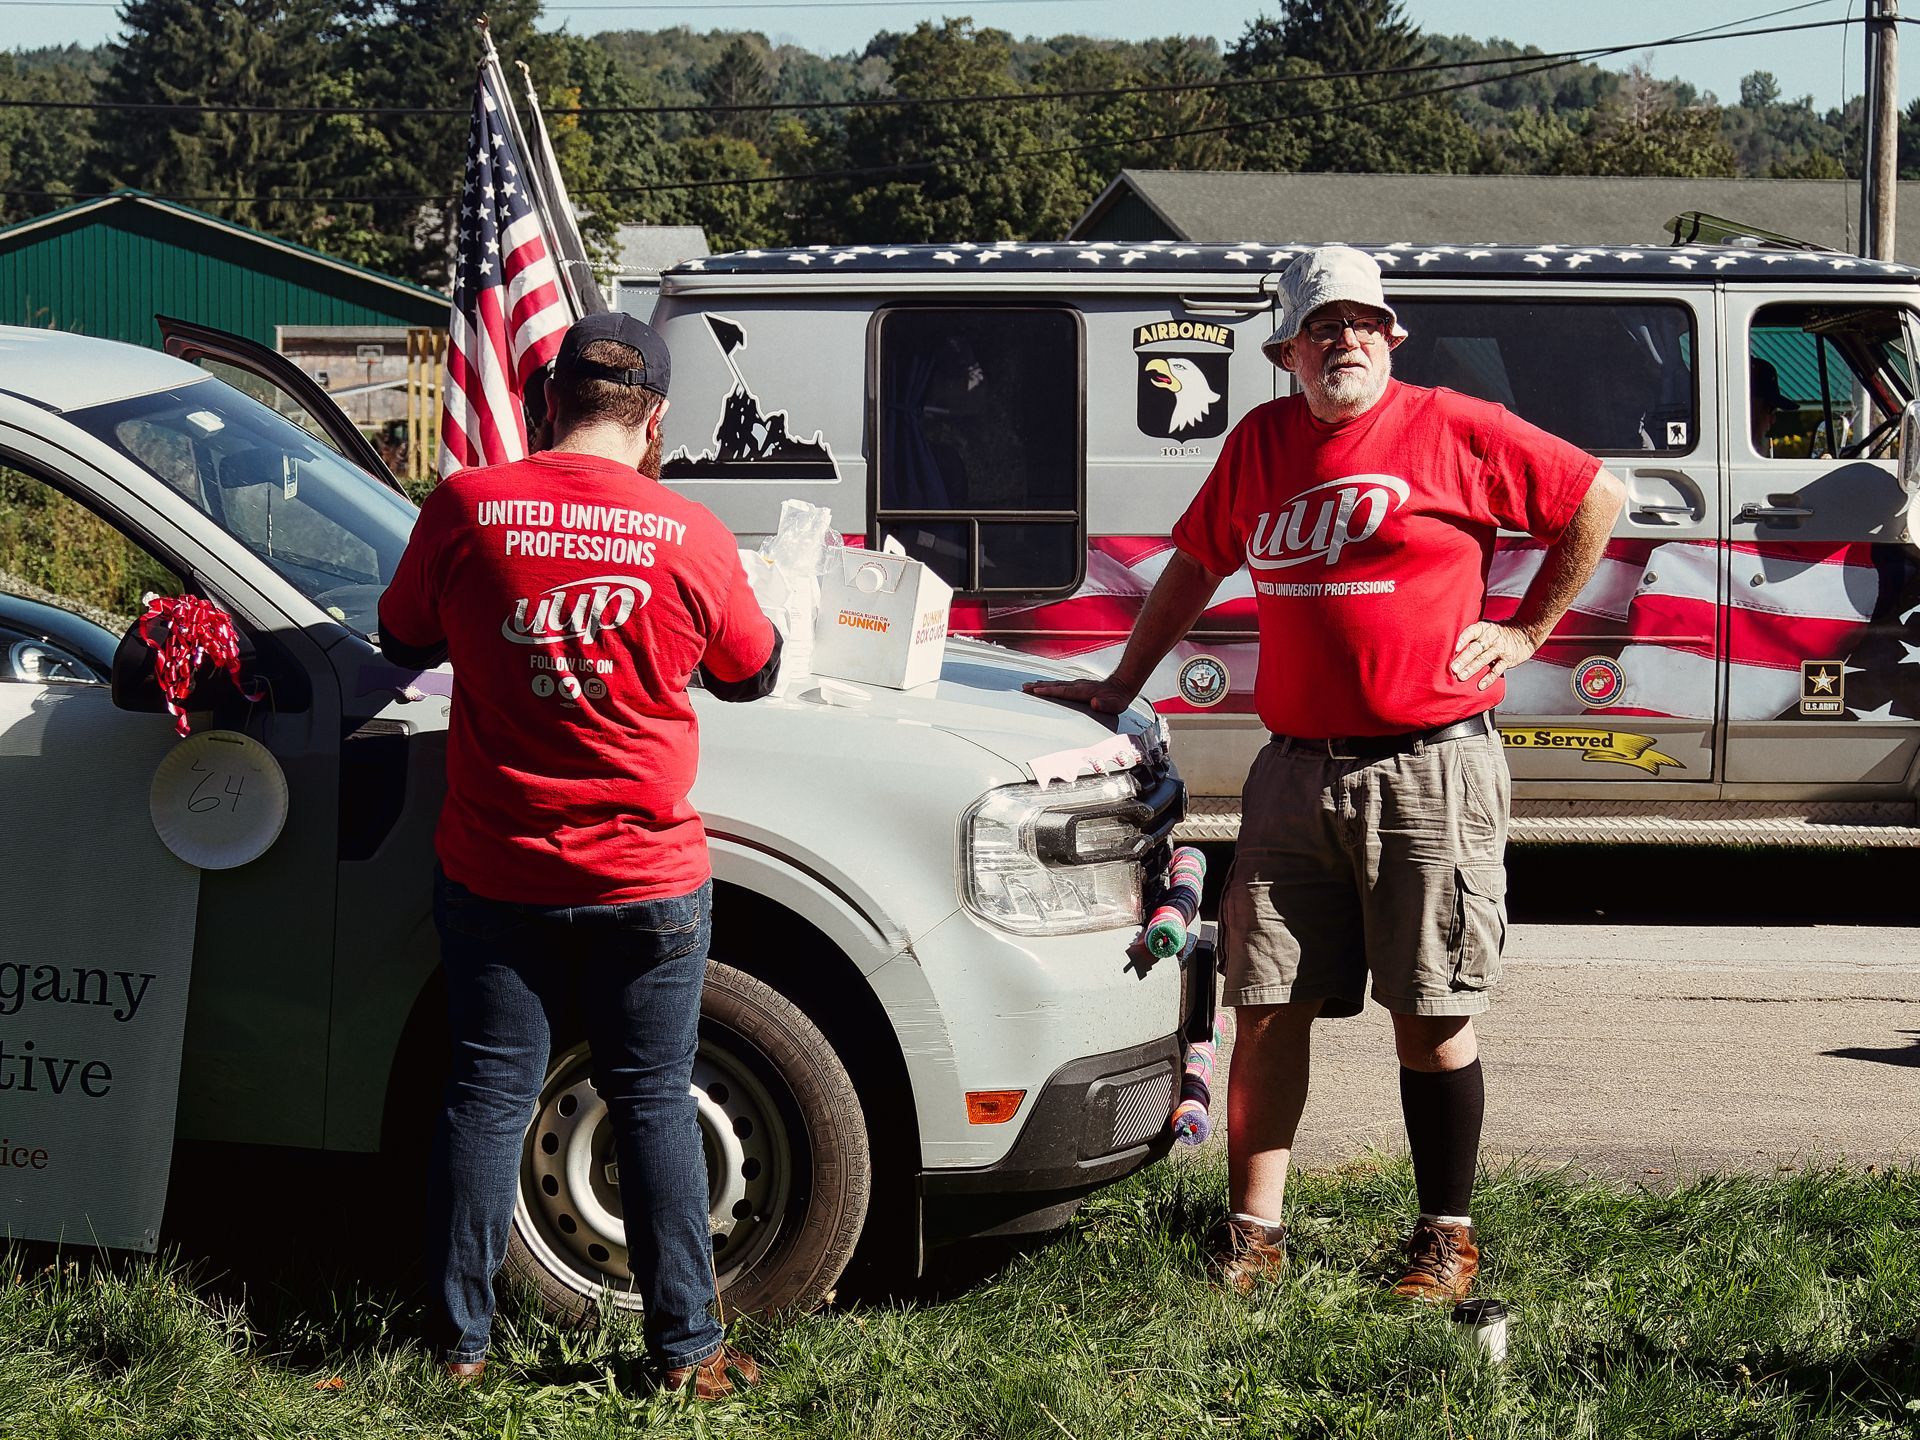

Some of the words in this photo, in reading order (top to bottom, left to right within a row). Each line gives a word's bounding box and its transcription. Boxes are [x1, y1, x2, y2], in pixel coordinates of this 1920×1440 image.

[1139, 322, 1229, 345] AIRBORNE
[1161, 446, 1200, 457] 101st
[478, 500, 555, 527] UNITED
[561, 503, 687, 546] UNIVERSITY
[1250, 484, 1392, 566] uup
[505, 530, 657, 568] PROFESSIONS
[1275, 582, 1323, 597] UNIVERSITY
[1324, 580, 1396, 596] PROFESSIONS
[512, 582, 638, 645] uup
[838, 614, 891, 633] DUNKIN'
[530, 655, 576, 672] FOLLOW
[578, 658, 594, 672] US
[596, 659, 614, 674] ON
[1533, 730, 1614, 748] Served
[187, 771, 245, 813] 64
